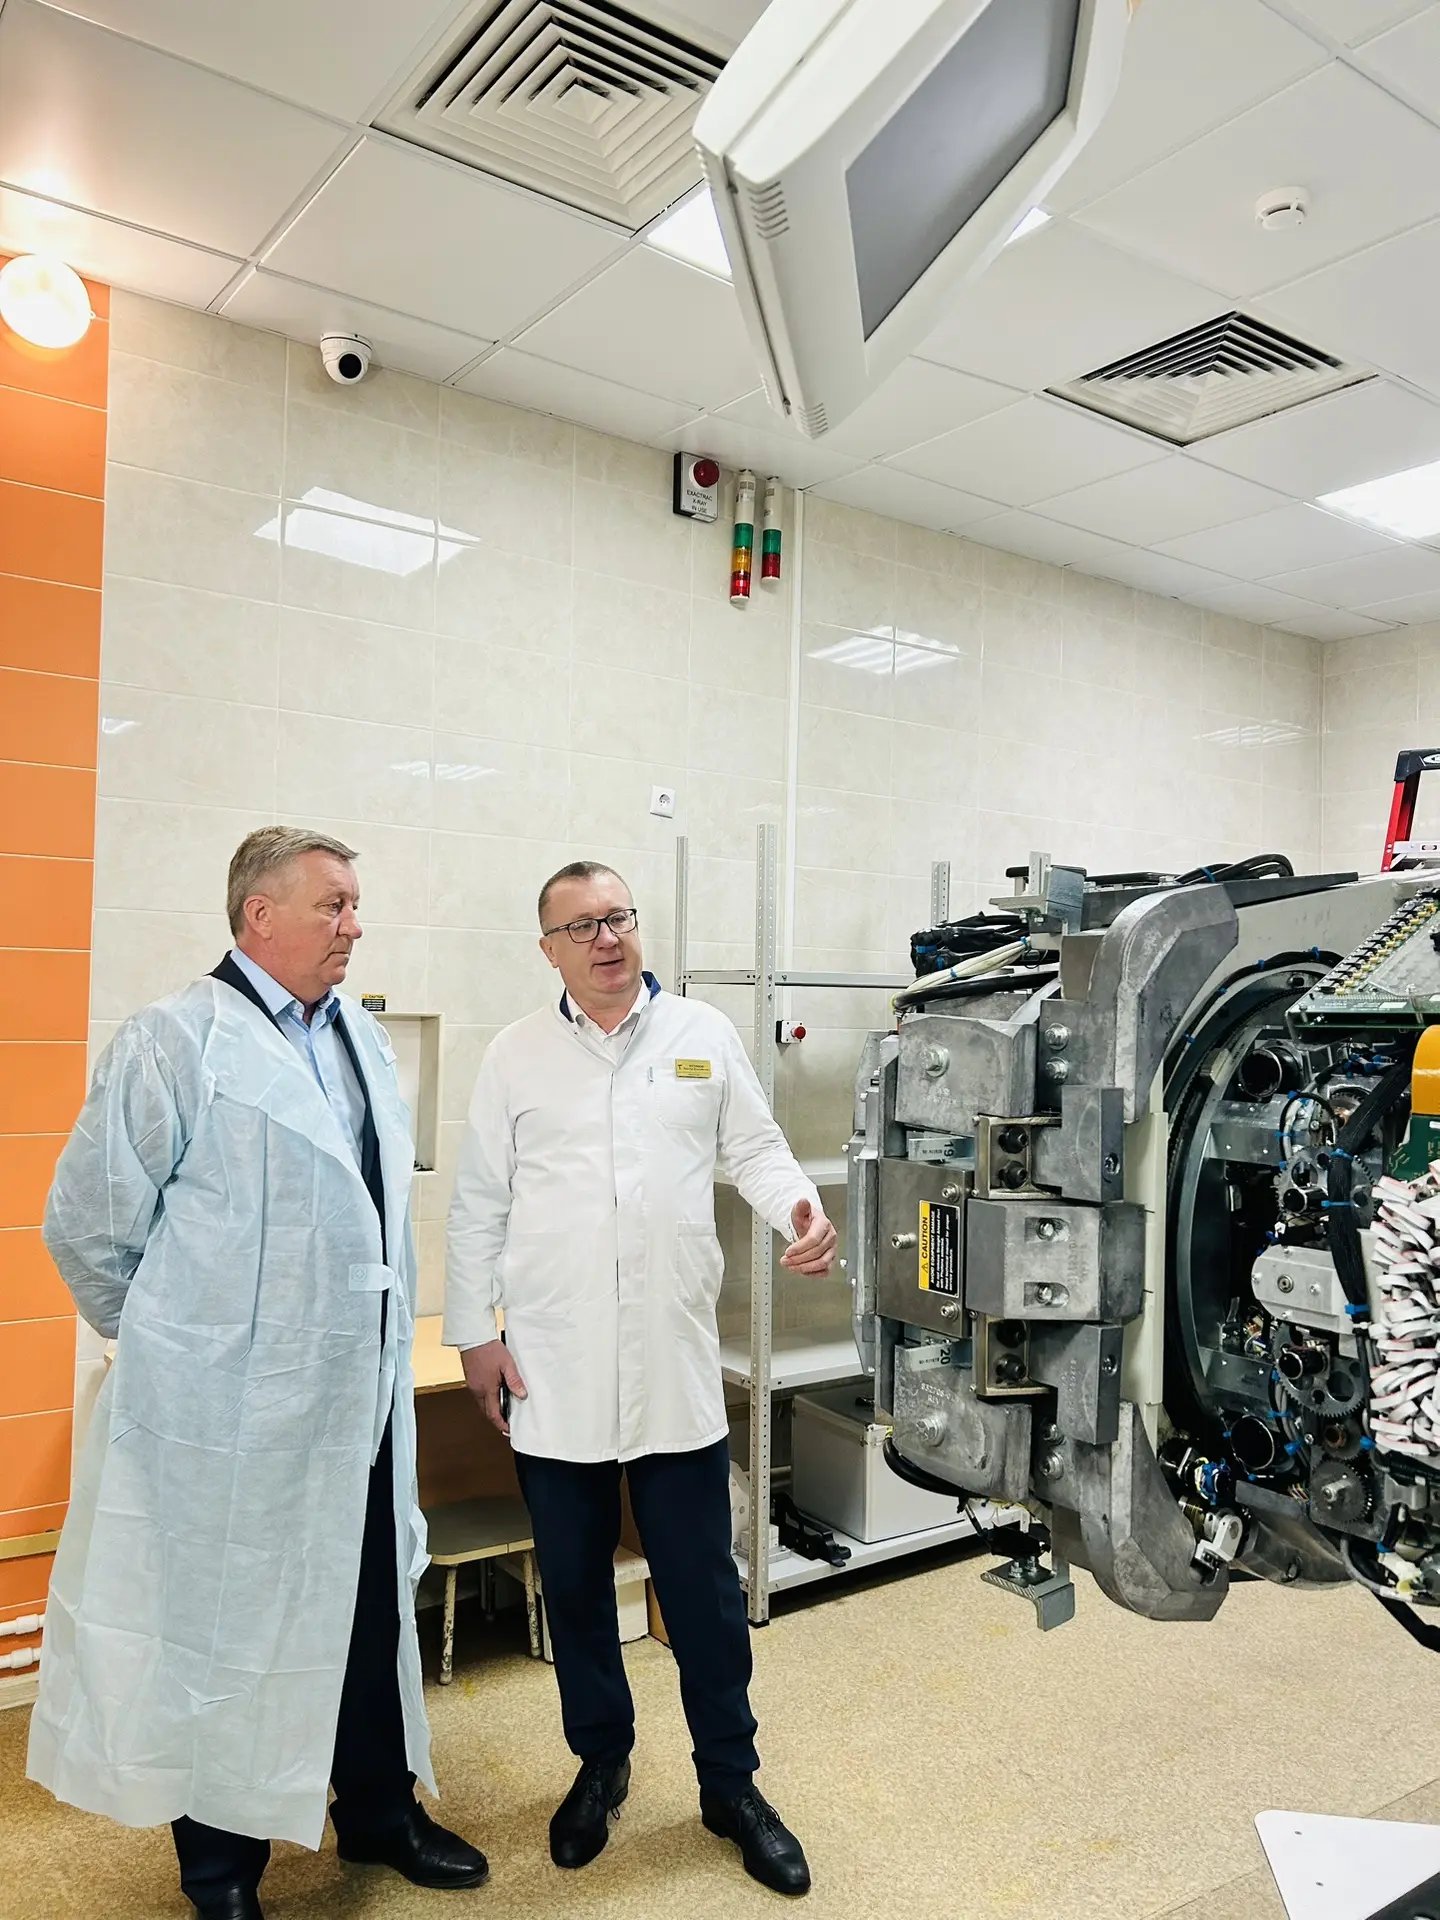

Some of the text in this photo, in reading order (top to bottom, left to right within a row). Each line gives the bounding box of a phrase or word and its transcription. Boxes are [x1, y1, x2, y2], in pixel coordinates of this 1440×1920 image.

[687, 489, 712, 501] EXACTRAC
[692, 498, 707, 506] X-RAY
[944, 1141, 954, 1157] 19
[940, 1348, 951, 1365] 20
